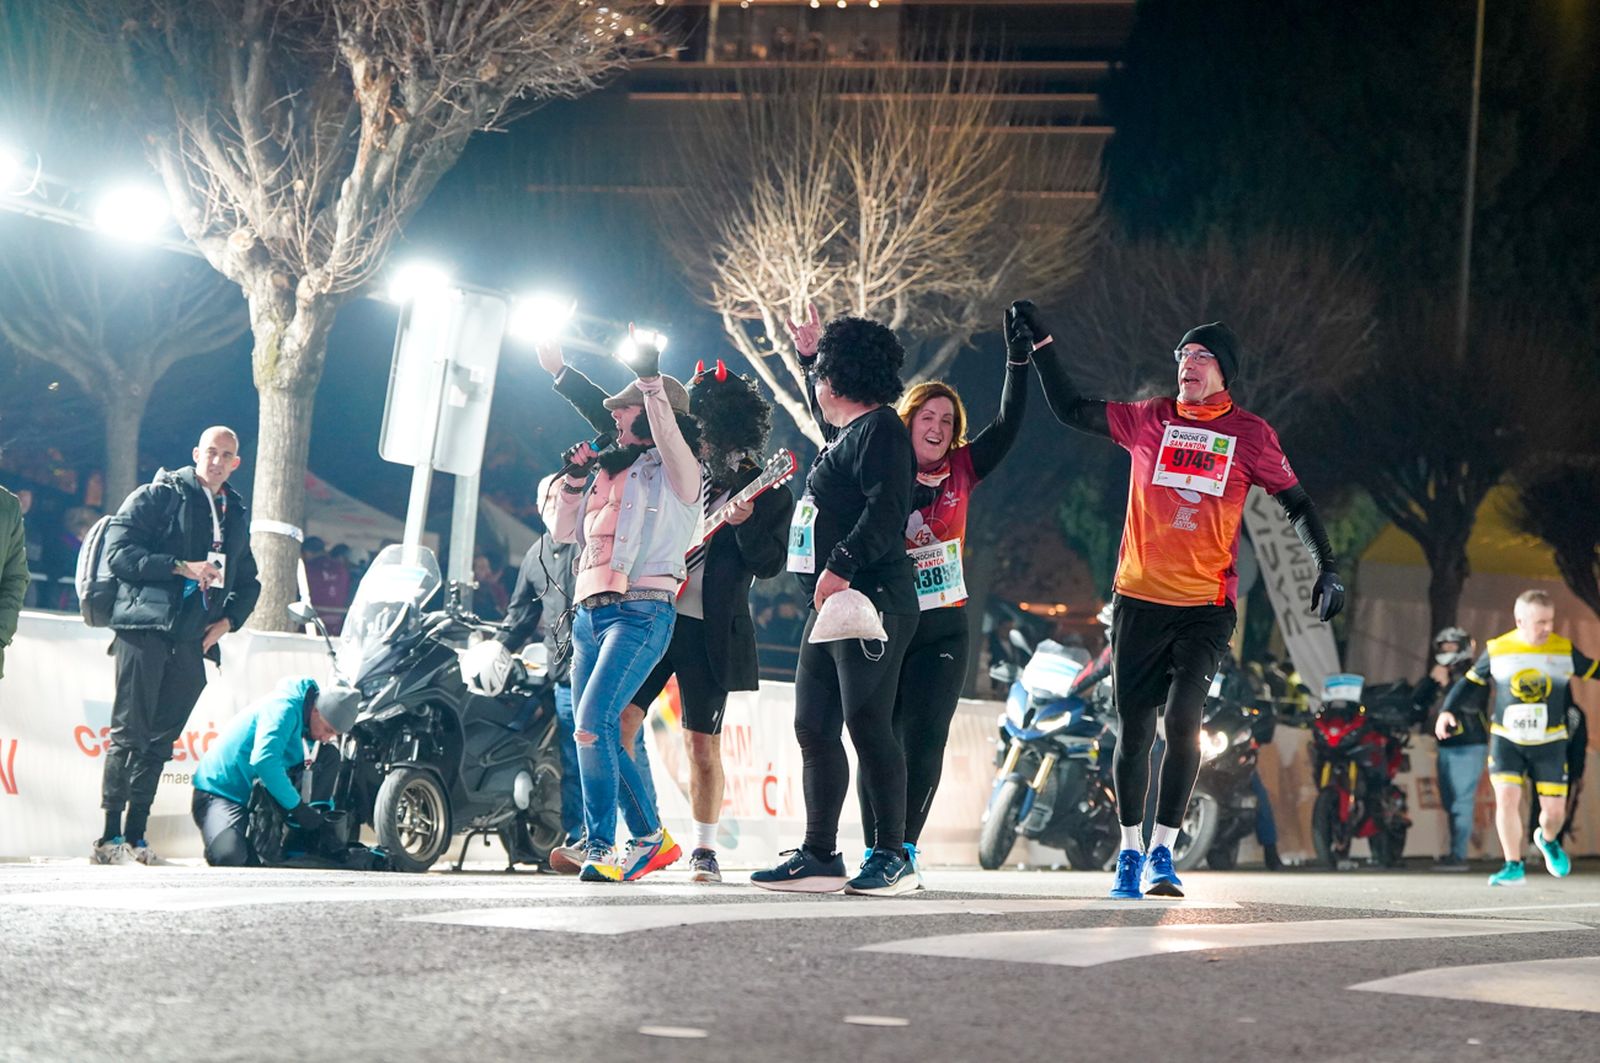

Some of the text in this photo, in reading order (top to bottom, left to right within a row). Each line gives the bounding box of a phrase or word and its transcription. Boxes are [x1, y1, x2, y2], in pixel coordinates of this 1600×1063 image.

[1169, 440, 1183, 448] SAN
[1179, 433, 1200, 442] NOCHE
[1172, 449, 1216, 471] 9745
[916, 552, 935, 560] NOCHE
[1250, 493, 1303, 637] DACIA
[722, 725, 752, 768] AN
